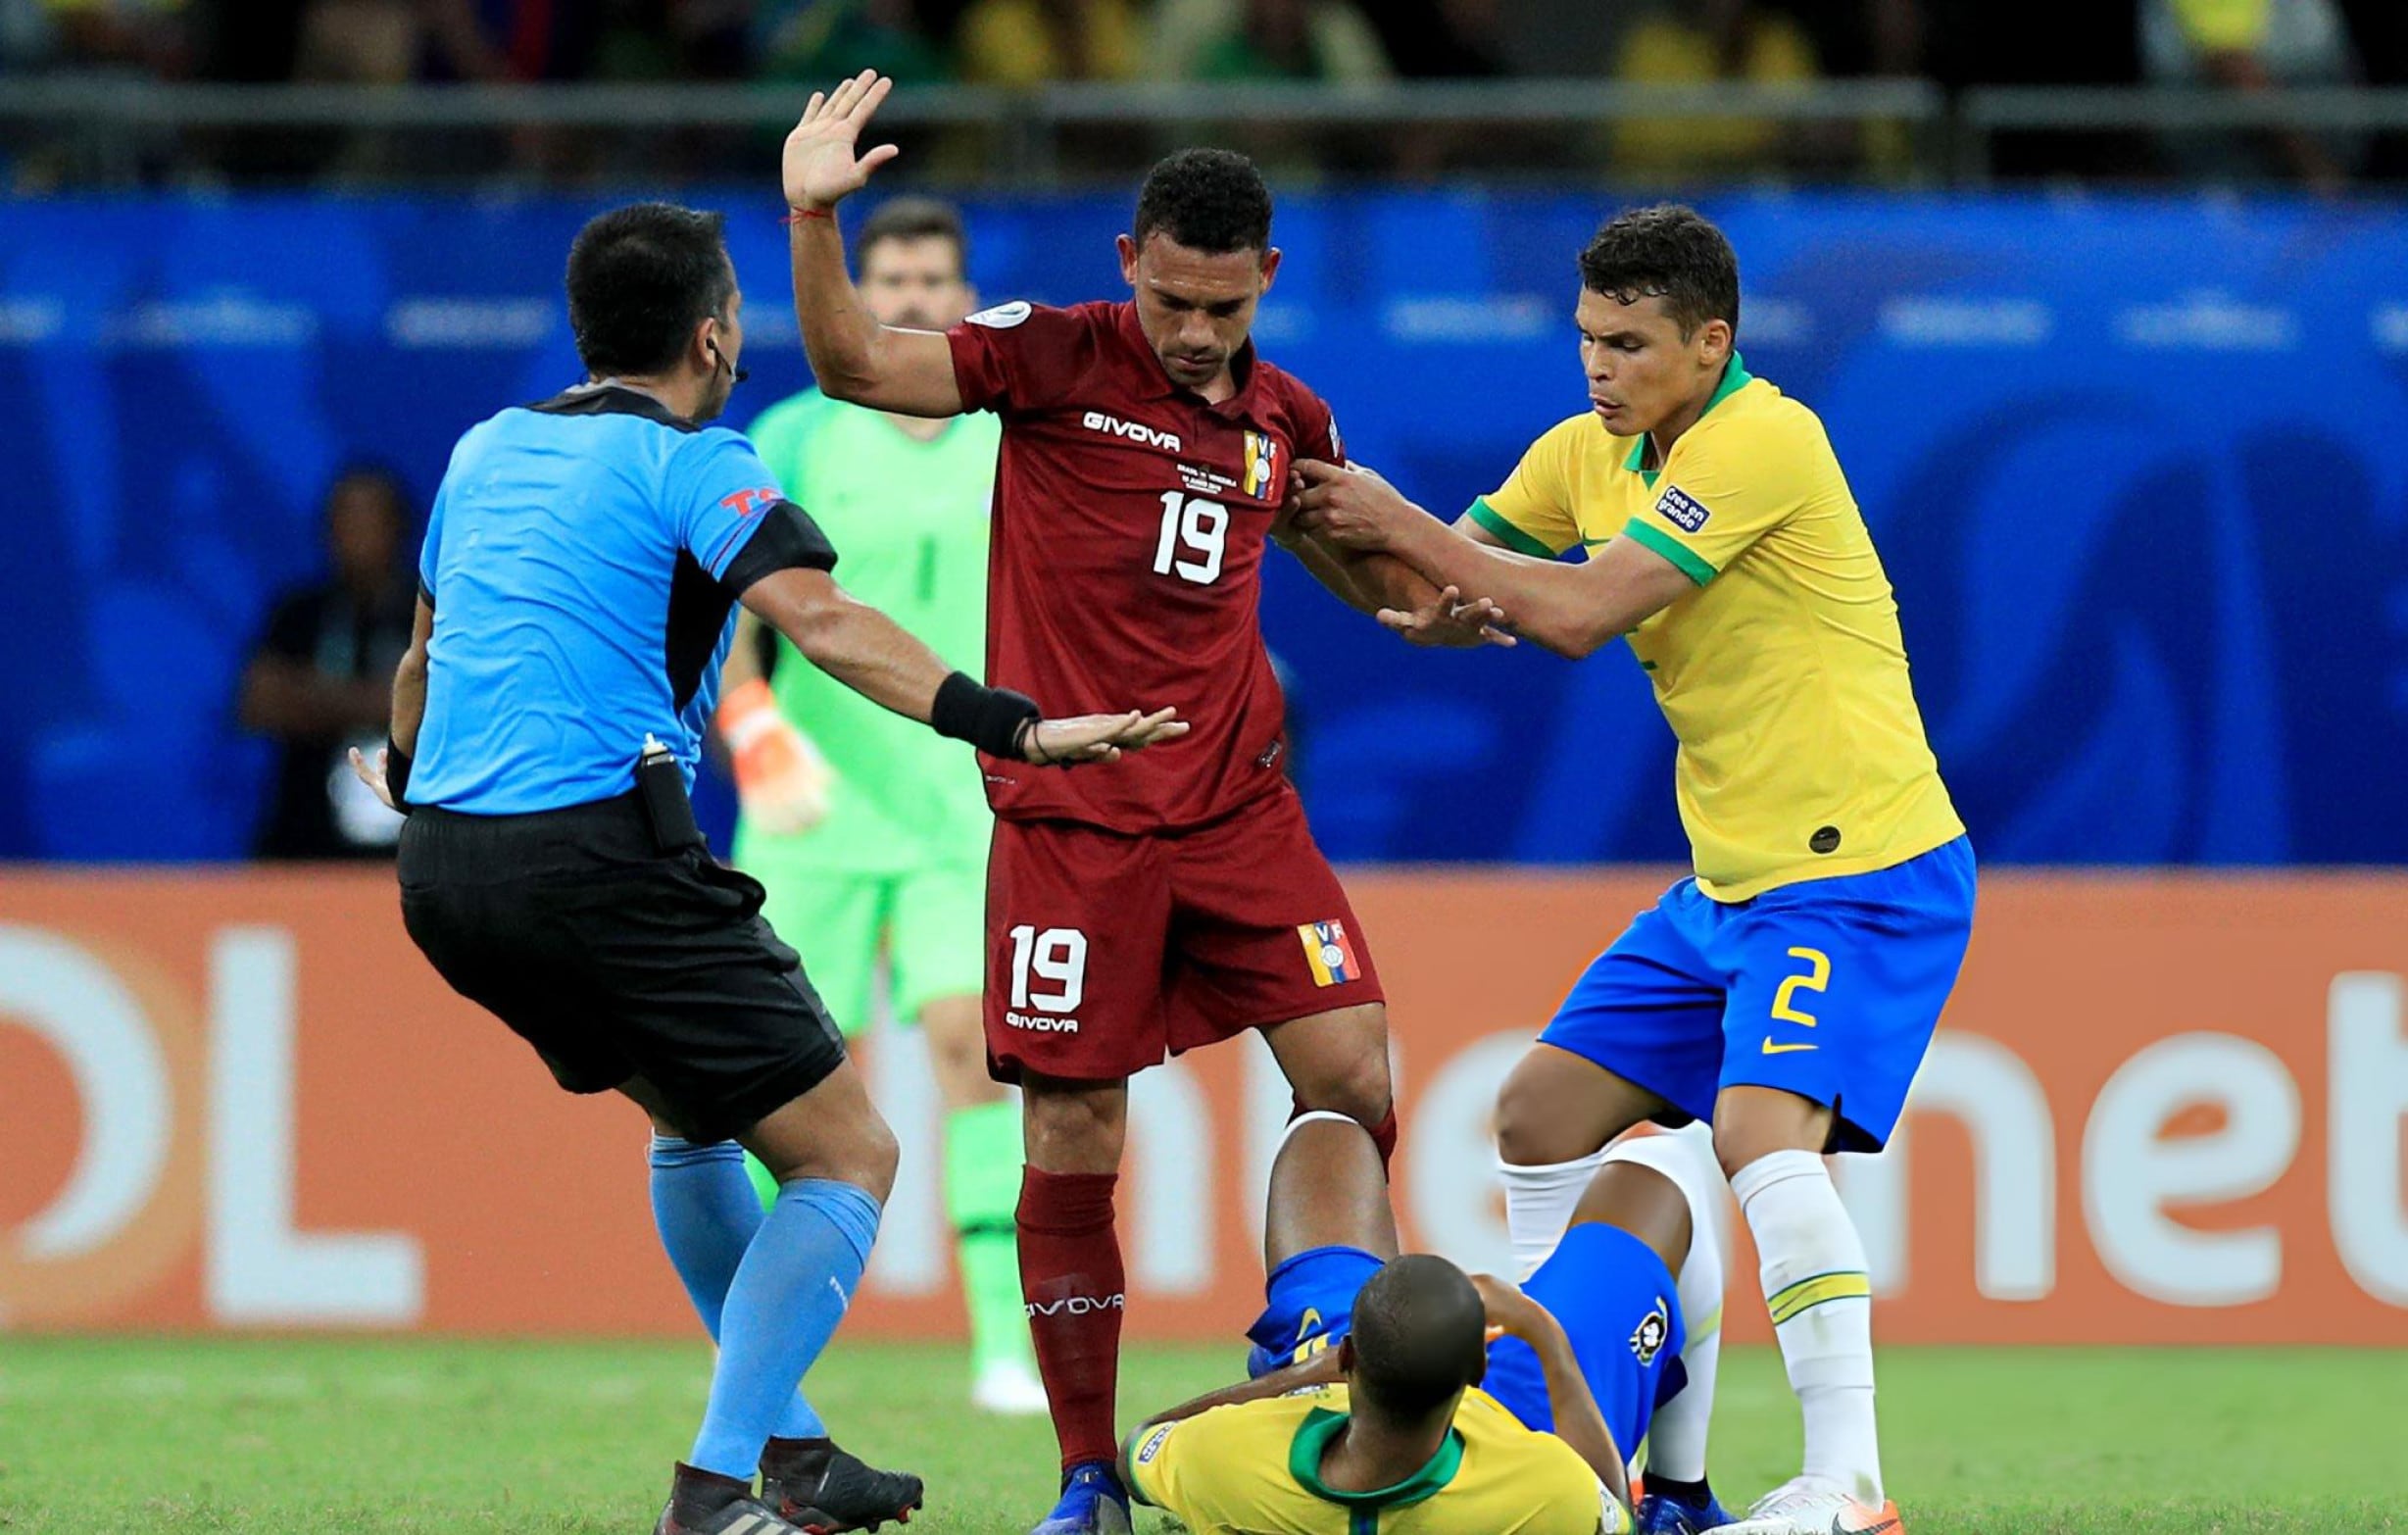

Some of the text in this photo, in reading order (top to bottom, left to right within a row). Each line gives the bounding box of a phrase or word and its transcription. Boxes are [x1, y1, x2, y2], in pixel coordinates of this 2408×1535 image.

[1082, 412, 1181, 453] GIVOVA
[1658, 499, 1695, 528] grande
[1666, 488, 1704, 521] Cree en
[1154, 491, 1229, 584] 19
[1009, 924, 1087, 1013] 19
[1771, 946, 1831, 1027] 2
[1007, 1013, 1078, 1032] GIVOVA
